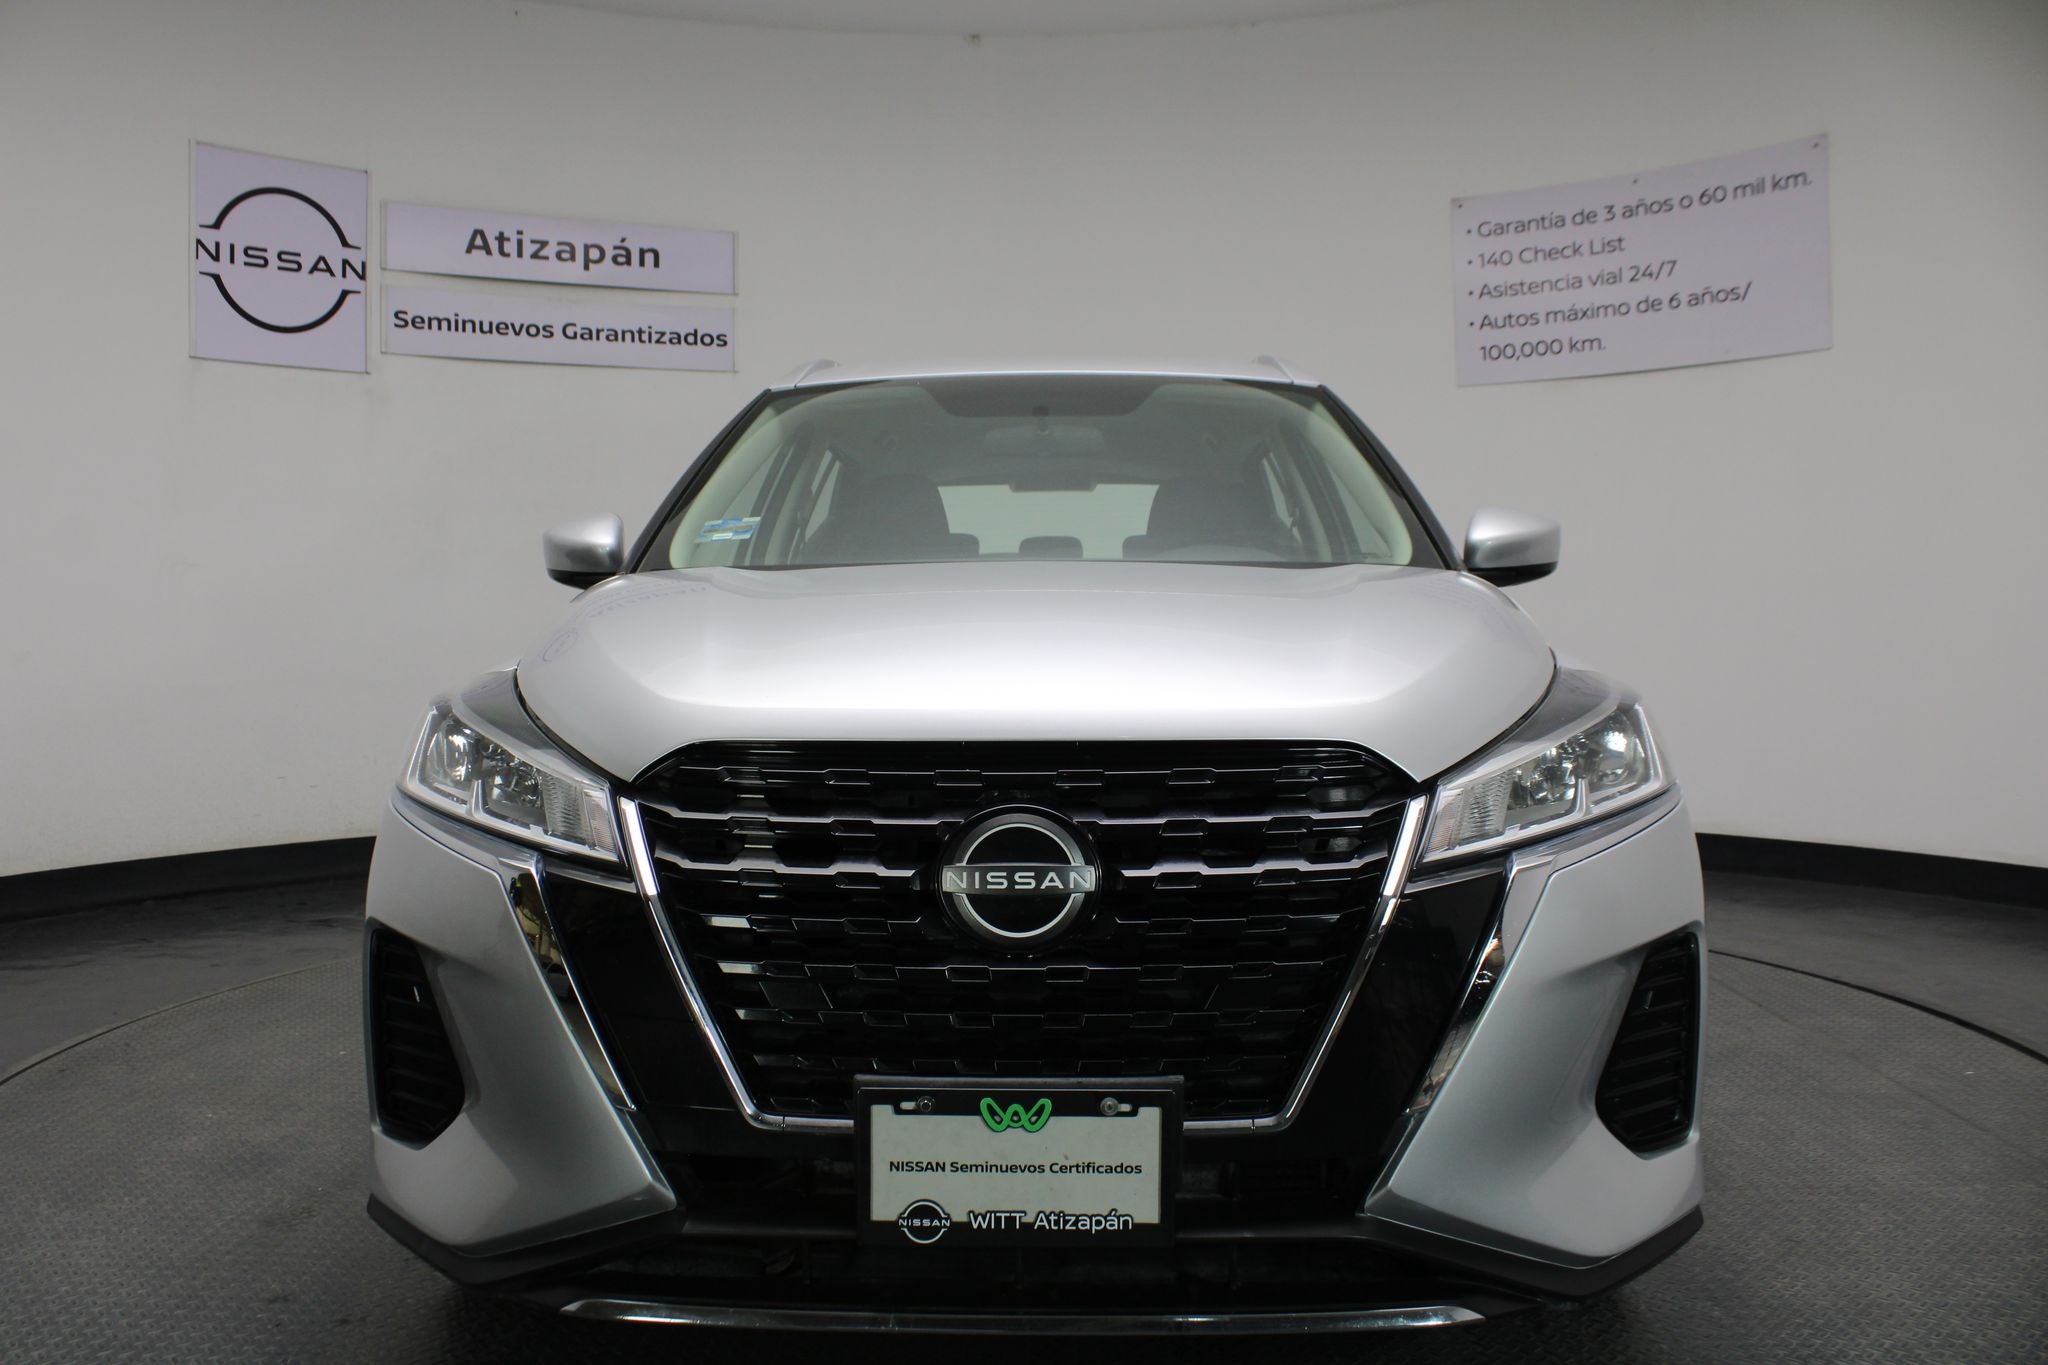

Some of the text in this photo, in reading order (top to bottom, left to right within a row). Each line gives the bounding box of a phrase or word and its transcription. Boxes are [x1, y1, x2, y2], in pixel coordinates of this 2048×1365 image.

[1477, 170, 1812, 238] Garantía de 3 años o 60 mil km.
[196, 238, 366, 281] NISSAN
[465, 227, 662, 272] Atizapán
[1478, 235, 1626, 268] 140 Check List
[1478, 260, 1678, 299] Asistencia vial 24/7
[1479, 281, 1752, 331] Autos máximo de 6 años/
[393, 309, 729, 347] Seminuevos Garantizados
[1480, 334, 1606, 362] 100,000 km.
[947, 872, 1090, 889] NISSAN
[889, 1161, 1142, 1174] NISSAN Seminuevos Certificados
[899, 1219, 950, 1227] NISSAN
[969, 1209, 1132, 1234] WITT Atizapán
